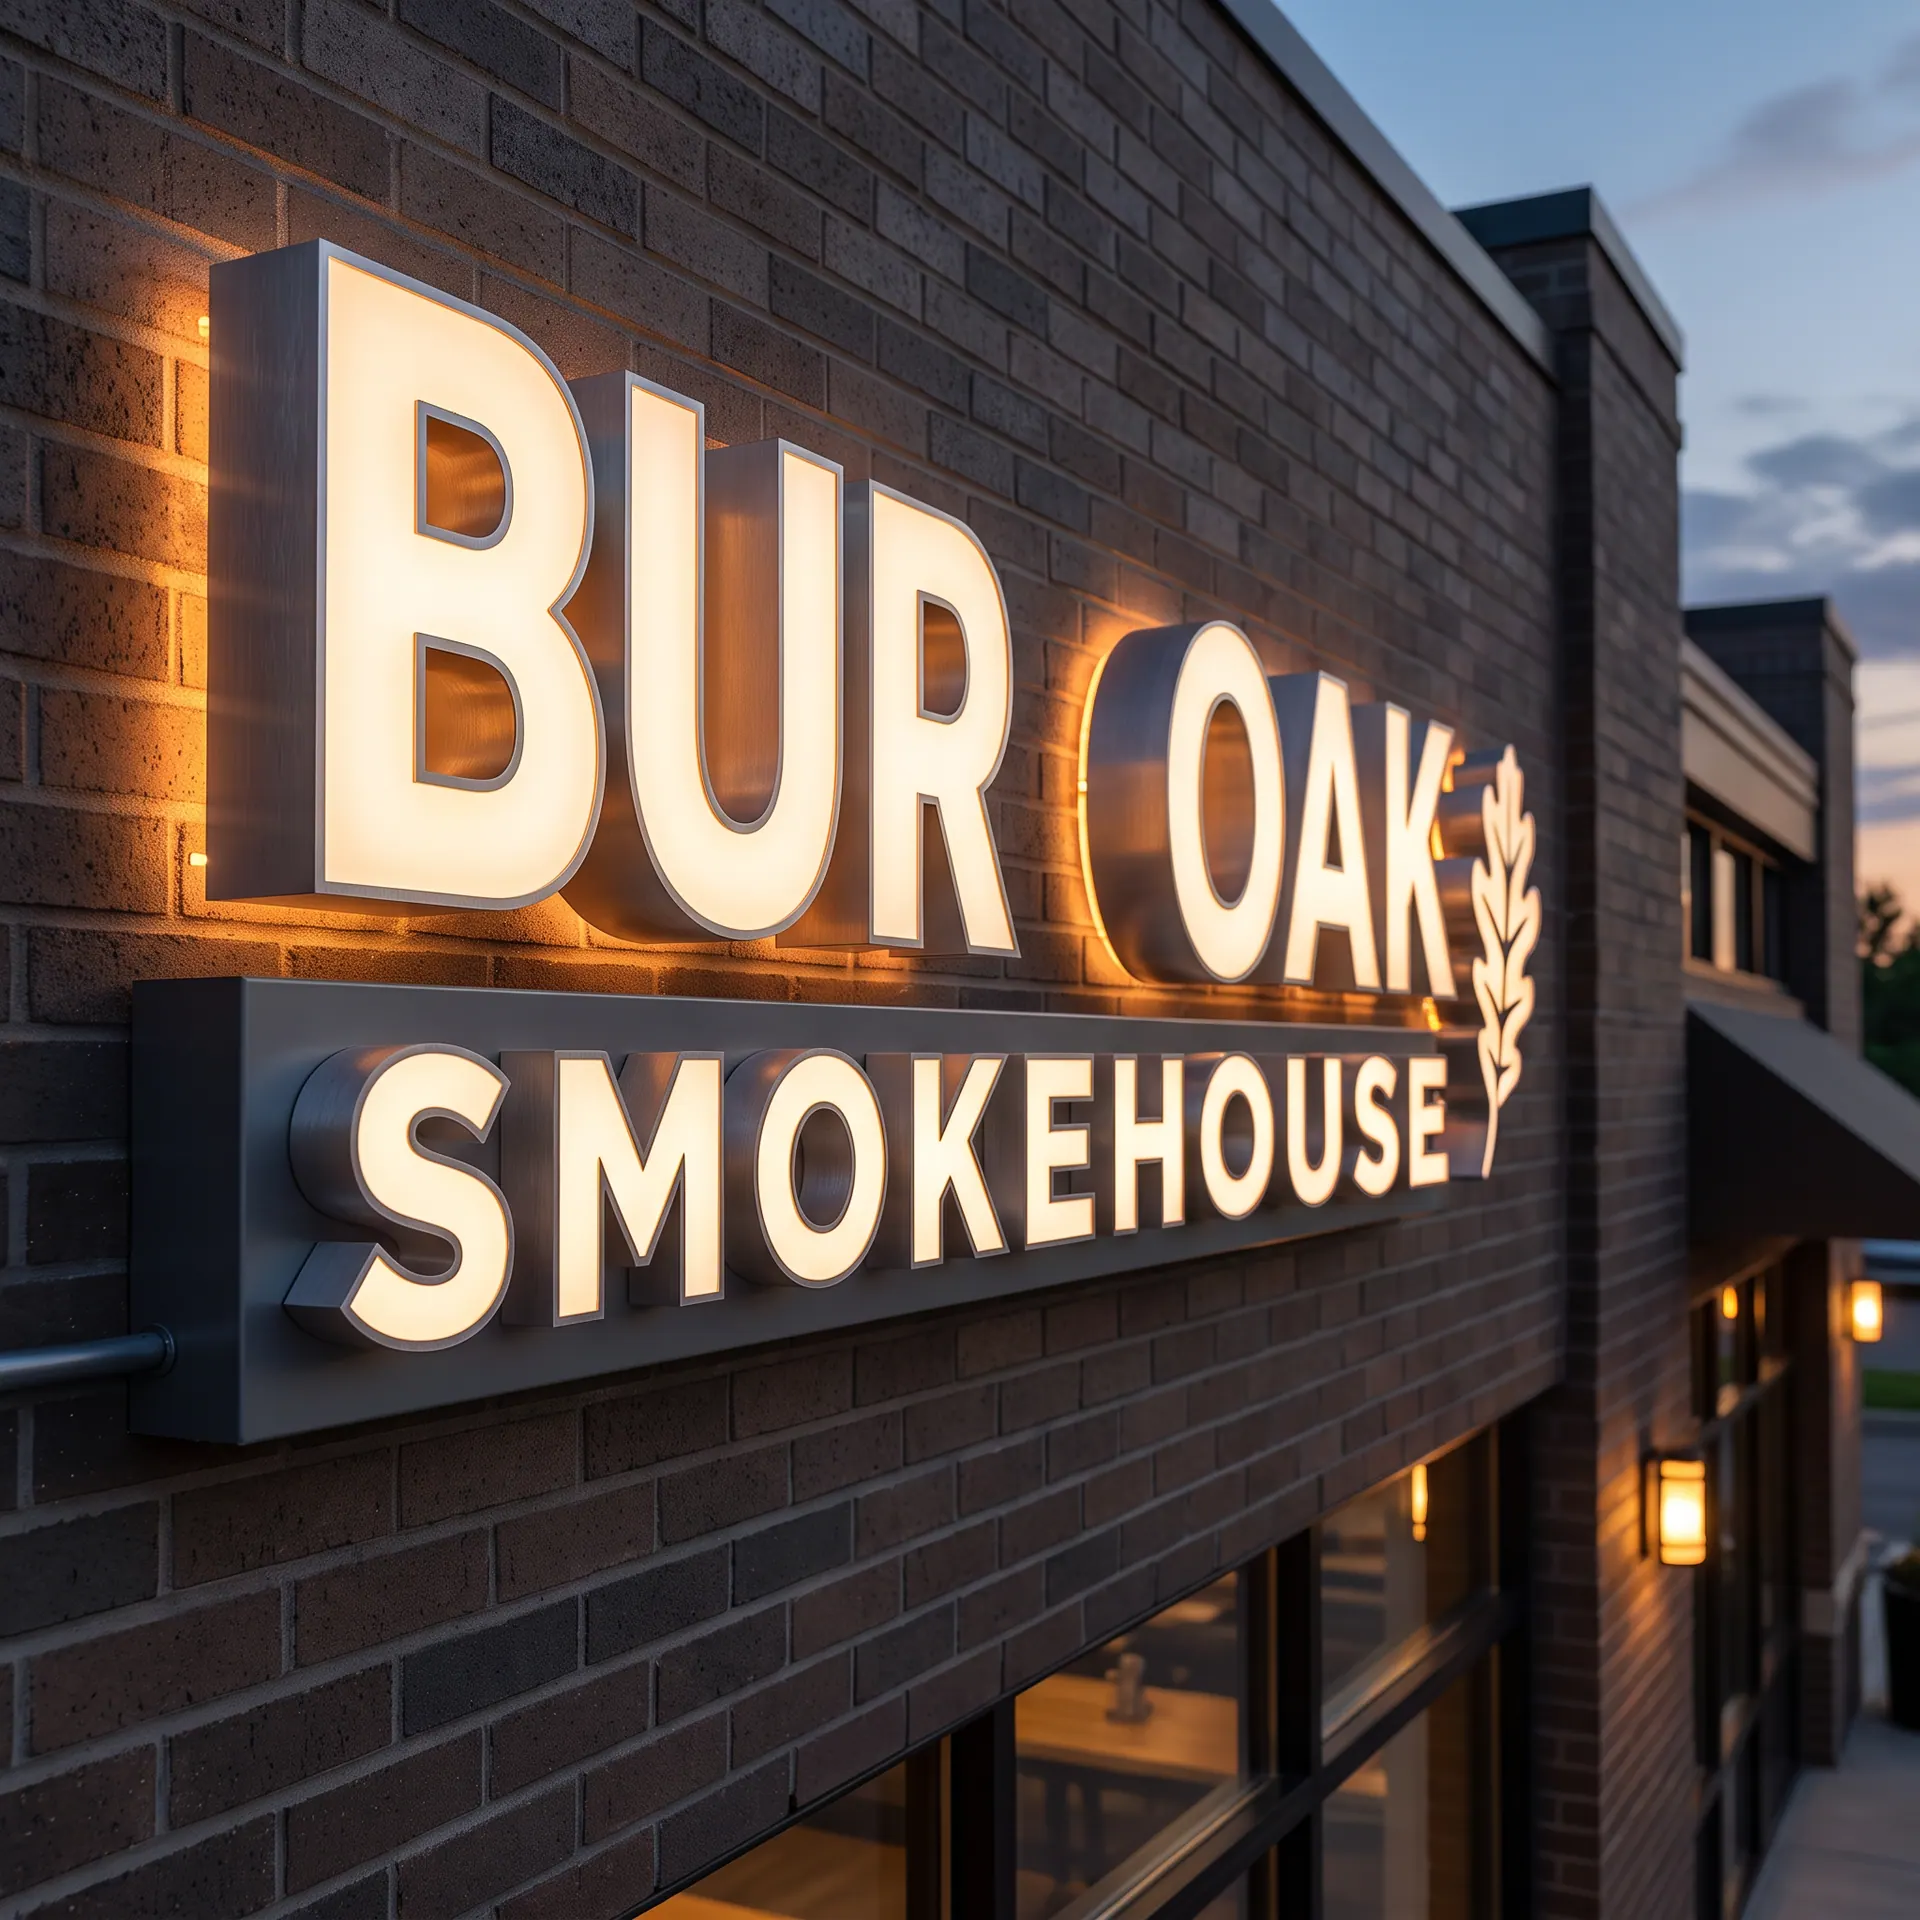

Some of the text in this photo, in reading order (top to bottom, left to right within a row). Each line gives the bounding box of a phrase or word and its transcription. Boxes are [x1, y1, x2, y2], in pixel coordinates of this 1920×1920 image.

[314, 240, 1458, 1001] BUR OAK
[341, 1042, 1451, 1353] SMOKEHOUSE
